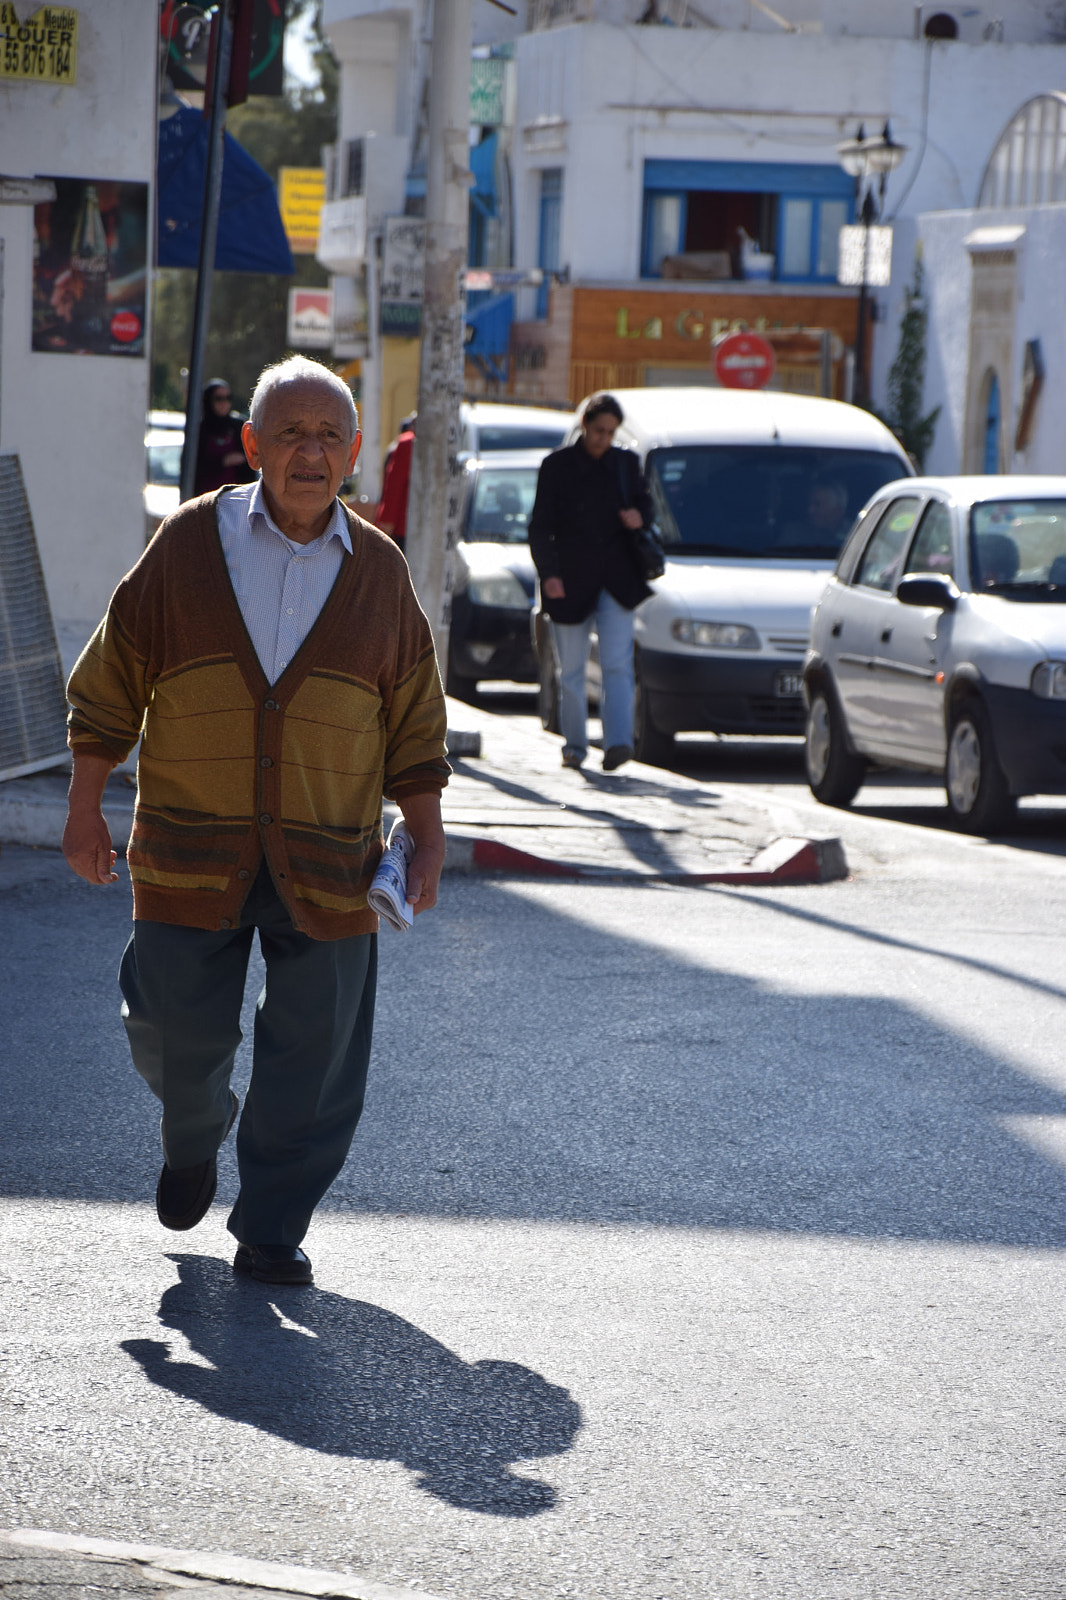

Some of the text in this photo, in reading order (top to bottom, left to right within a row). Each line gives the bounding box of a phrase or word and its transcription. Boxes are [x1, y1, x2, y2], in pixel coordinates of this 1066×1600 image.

[6, 25, 72, 47] LOUER
[5, 42, 70, 78] 55 876 184
[616, 307, 663, 340] La
